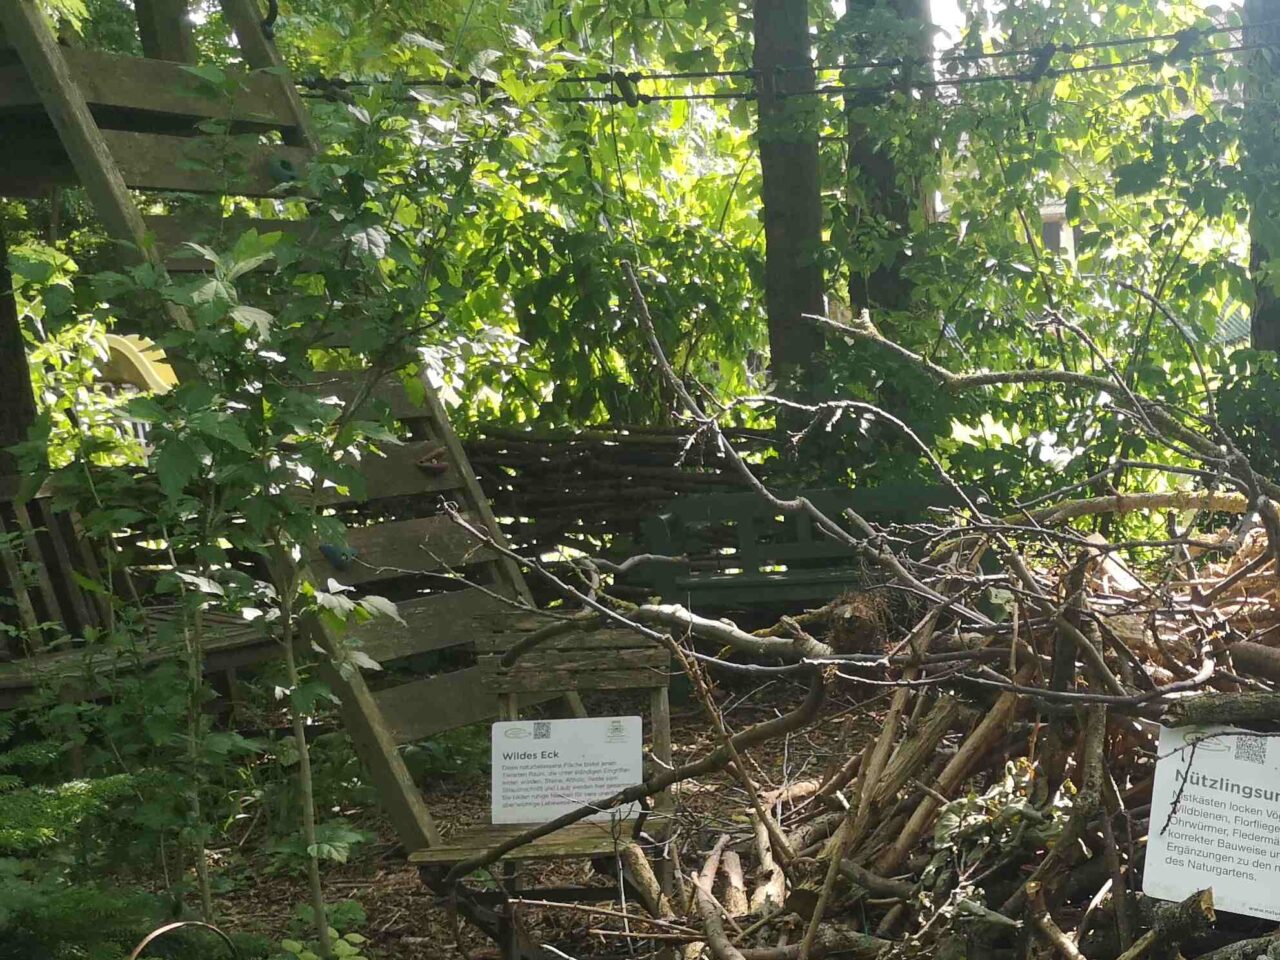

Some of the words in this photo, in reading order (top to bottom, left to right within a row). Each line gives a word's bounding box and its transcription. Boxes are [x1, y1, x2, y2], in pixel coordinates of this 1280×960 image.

[502, 751, 538, 760] Wildes
[541, 749, 560, 759] Eck
[1229, 801, 1263, 816] locken
[1169, 816, 1230, 837] Ohrwürmer,
[1167, 828, 1214, 846] korrekter
[1217, 838, 1267, 856] Bauweise
[1166, 841, 1235, 863] Ergänzungen
[1237, 857, 1249, 866] zu
[1252, 859, 1272, 870] den
[1165, 855, 1184, 867] des
[1187, 859, 1257, 881] Naturgartens.
